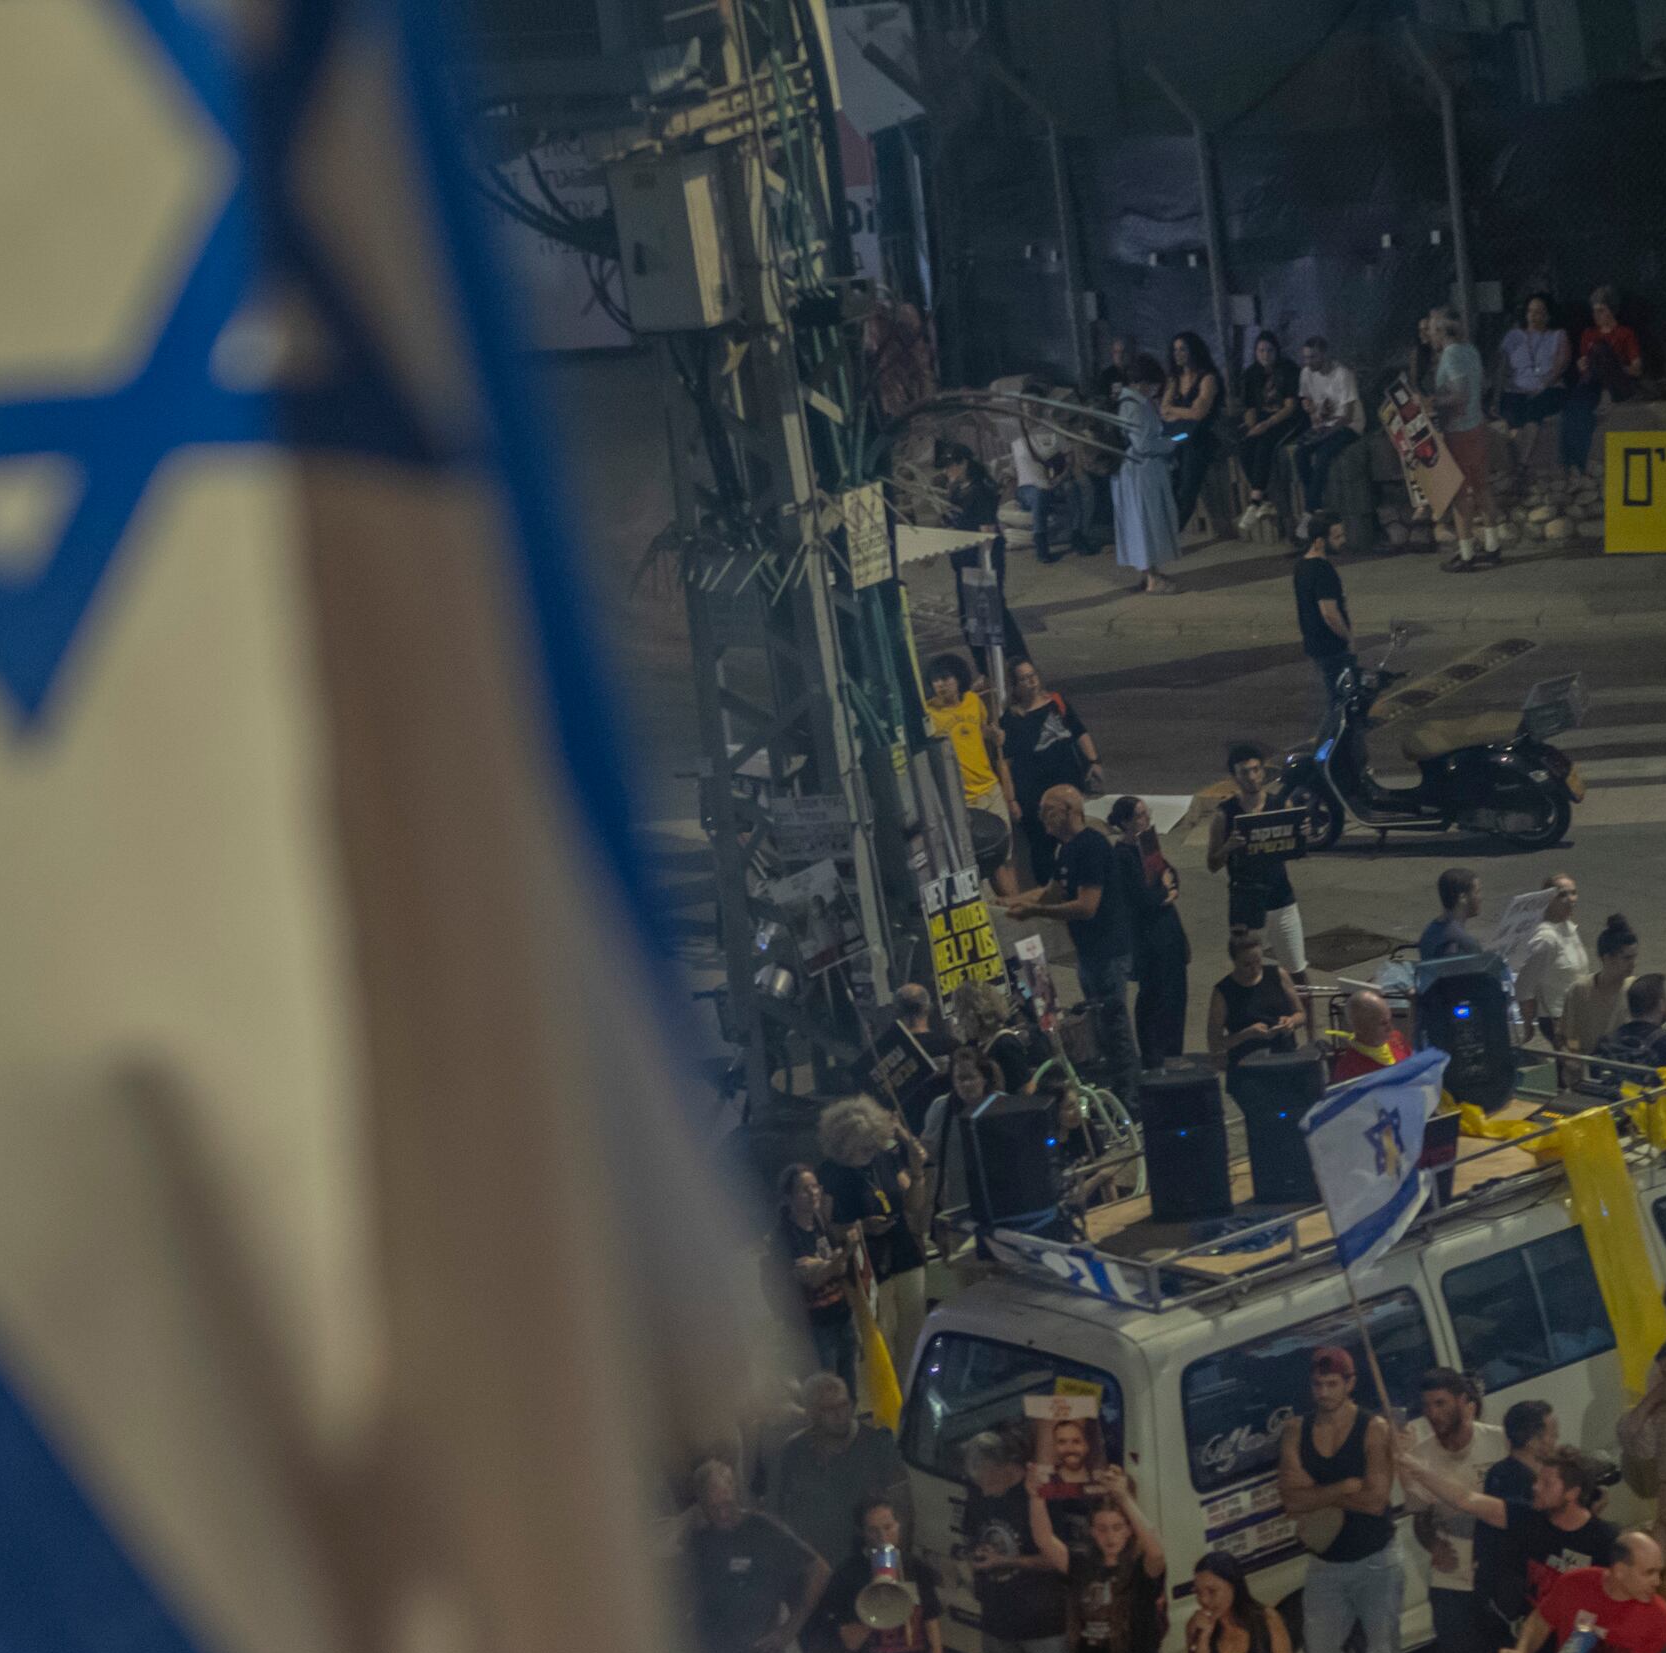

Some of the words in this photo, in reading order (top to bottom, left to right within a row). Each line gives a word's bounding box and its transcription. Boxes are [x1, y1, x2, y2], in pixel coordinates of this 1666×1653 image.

[923, 879, 949, 915] HEY
[933, 932, 974, 972] HELP
[974, 925, 998, 958] US
